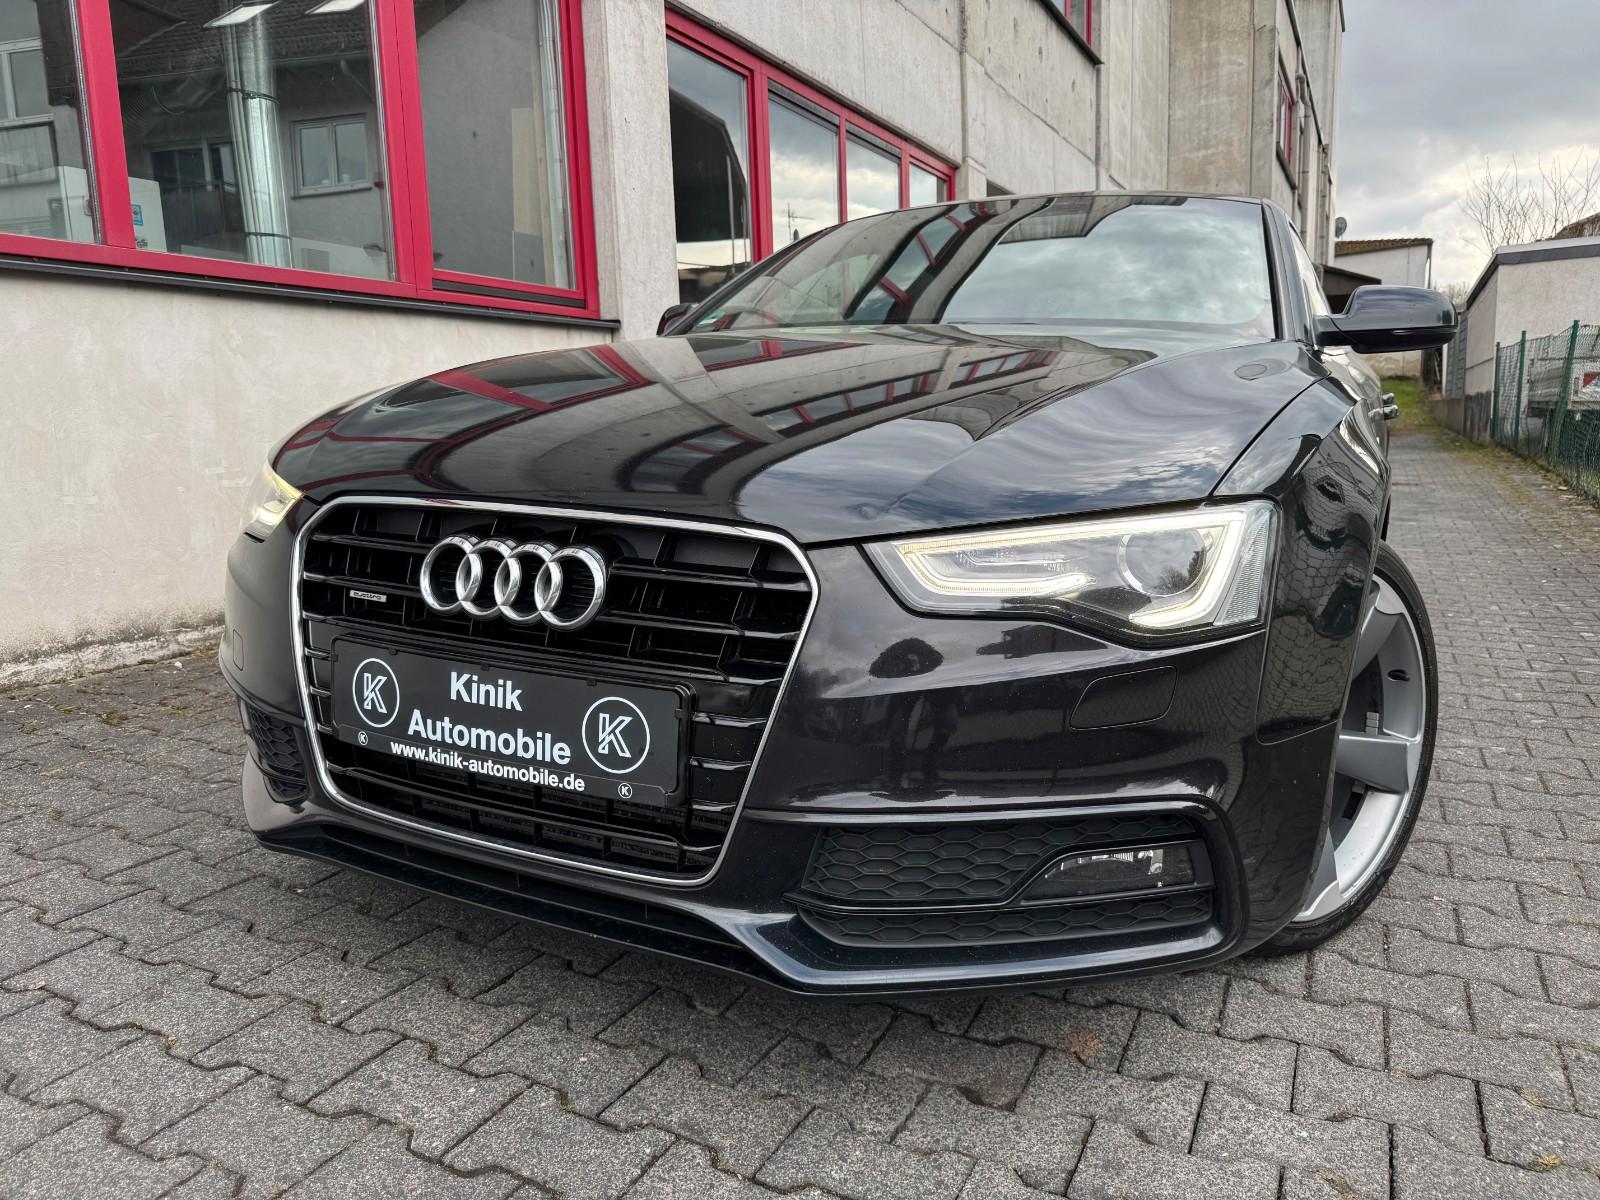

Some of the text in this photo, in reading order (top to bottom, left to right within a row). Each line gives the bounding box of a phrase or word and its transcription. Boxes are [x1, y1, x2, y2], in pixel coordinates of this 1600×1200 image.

[362, 672, 388, 713] K
[450, 671, 523, 711] Kinik
[408, 709, 571, 765] Automobile
[598, 713, 633, 758] K
[391, 742, 585, 792] www.kinik-automobile.de
